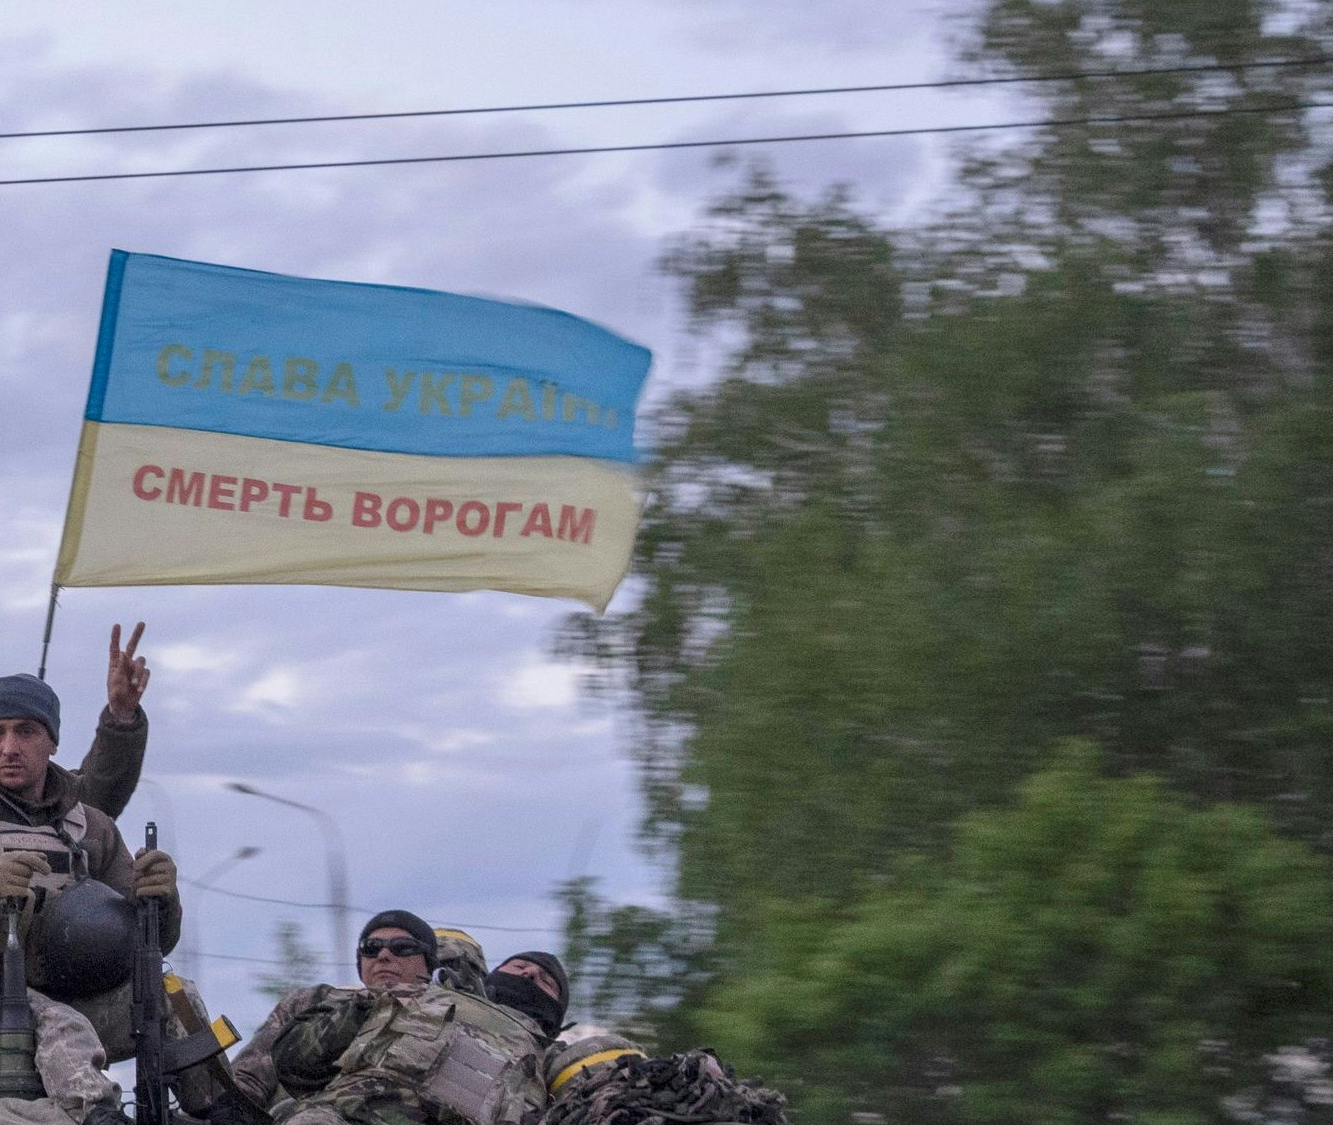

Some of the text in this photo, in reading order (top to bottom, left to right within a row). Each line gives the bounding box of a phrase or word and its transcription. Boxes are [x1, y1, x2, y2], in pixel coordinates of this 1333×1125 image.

[156, 343, 361, 408] СЛАВА
[133, 464, 596, 545] СМЕРТЬ ВОРОГАМ
